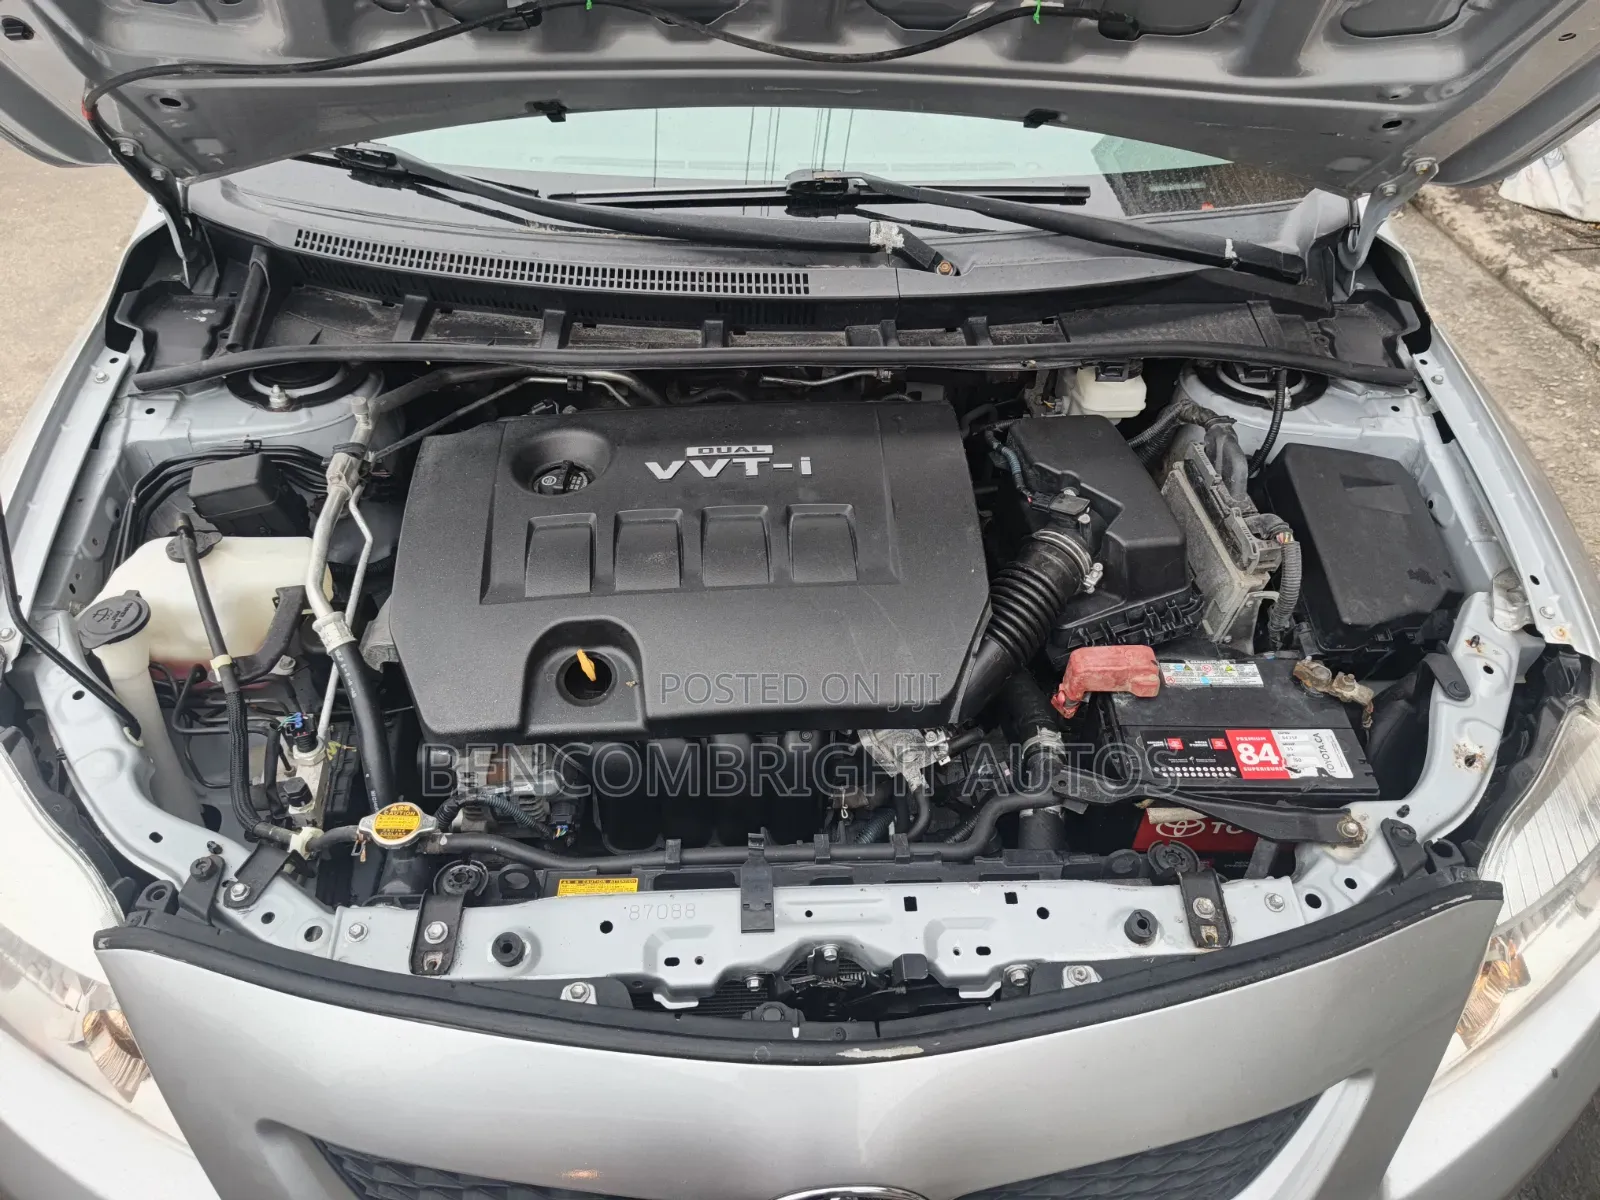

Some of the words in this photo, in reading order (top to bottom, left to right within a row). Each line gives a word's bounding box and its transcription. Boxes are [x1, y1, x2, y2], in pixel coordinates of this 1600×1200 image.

[698, 446, 765, 454] DUAL
[1237, 743, 1280, 765] 84
[1312, 733, 1336, 773] TOYOTA.CA
[628, 903, 696, 921] 87088
